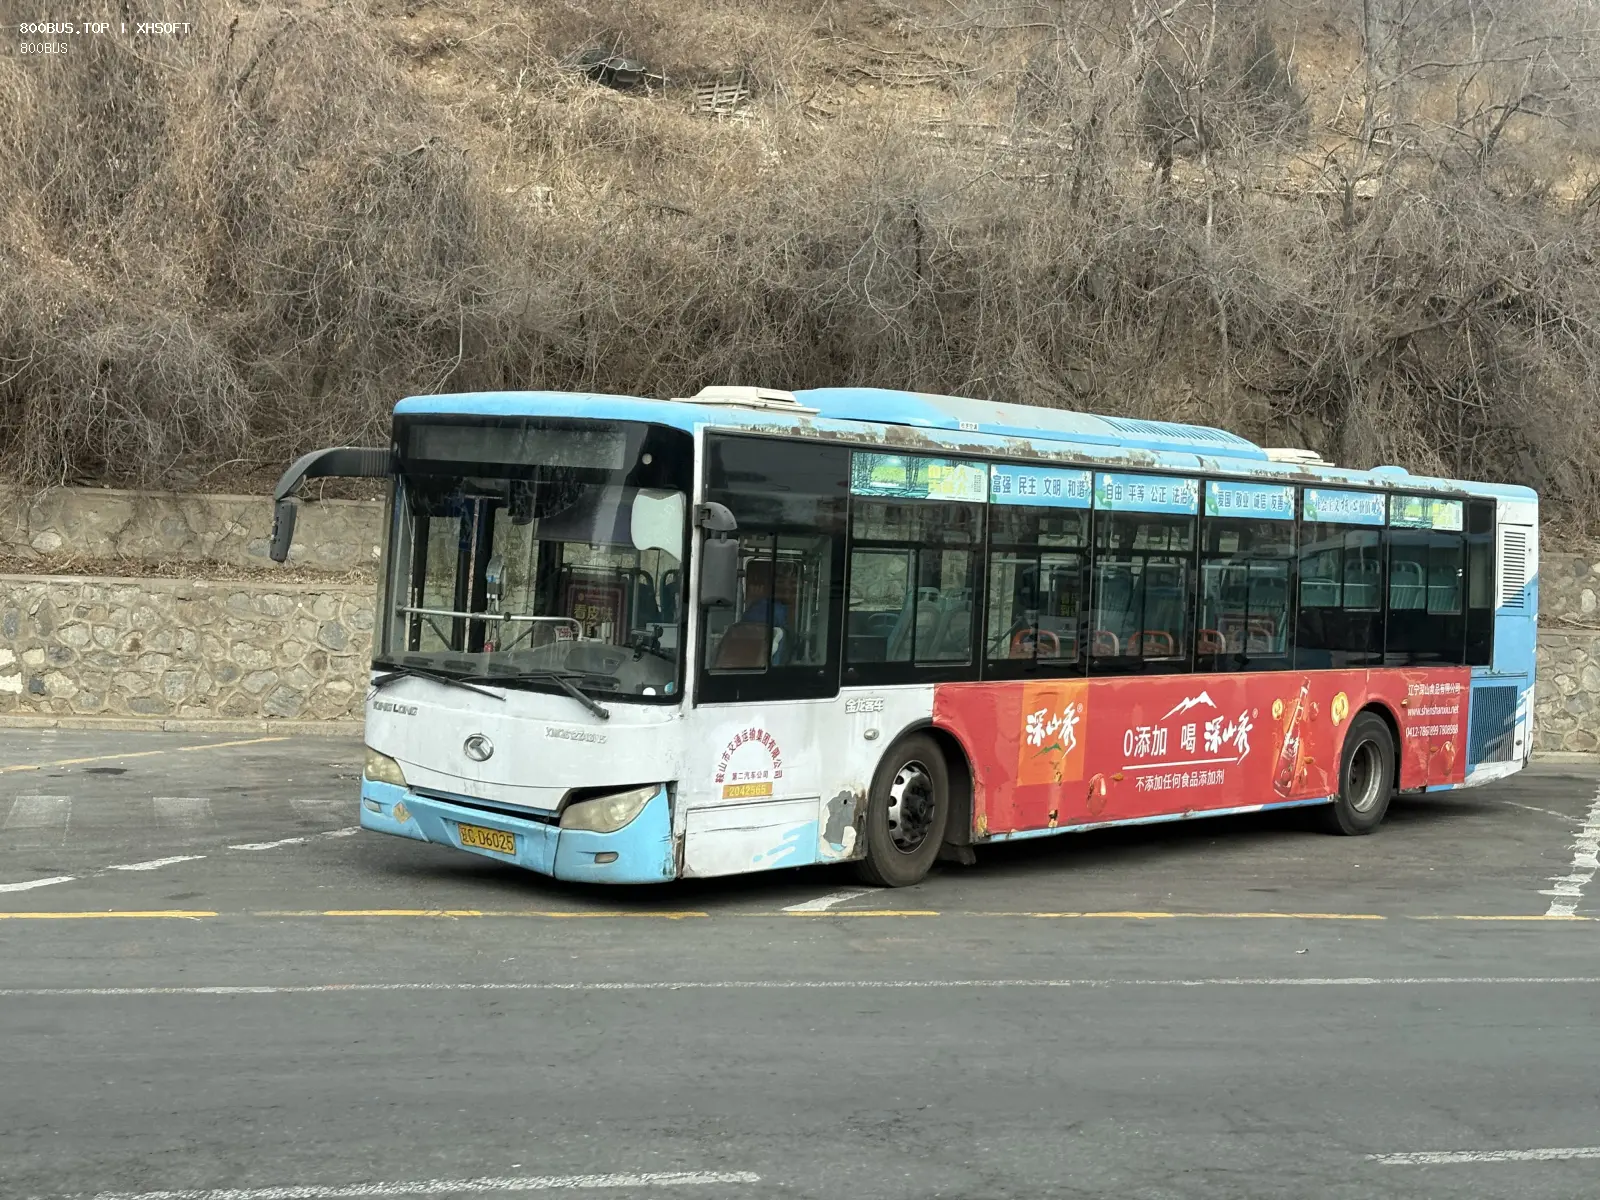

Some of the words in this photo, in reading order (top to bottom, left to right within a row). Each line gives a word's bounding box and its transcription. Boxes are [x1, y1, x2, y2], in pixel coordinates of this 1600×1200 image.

[992, 474, 1011, 495] 富强
[1018, 476, 1037, 496] 民主
[1043, 477, 1061, 497] 文明
[1067, 479, 1086, 499] 和谐
[1106, 484, 1123, 501] 自由
[1128, 485, 1145, 502] 平等
[1150, 486, 1167, 504] 公正
[1172, 487, 1188, 505] 法治
[1217, 491, 1231, 508] 爱国
[1236, 492, 1250, 509] 敬业
[1253, 492, 1267, 510] 诚信
[1270, 493, 1284, 511] 友善
[373, 701, 393, 712] KING
[393, 704, 418, 716] LONG
[845, 697, 884, 714] 金龙客车
[1025, 701, 1080, 759] 深山秀
[1123, 728, 1167, 758] 0添加
[1180, 723, 1196, 754] 喝
[1203, 708, 1254, 766] 深山秀
[714, 727, 783, 783] 鞍山市交通运输集团有限公司
[732, 770, 769, 780] 第二汽车公司
[1134, 768, 1225, 792] 不添加任何食品添加剂
[728, 784, 766, 797] 2042565
